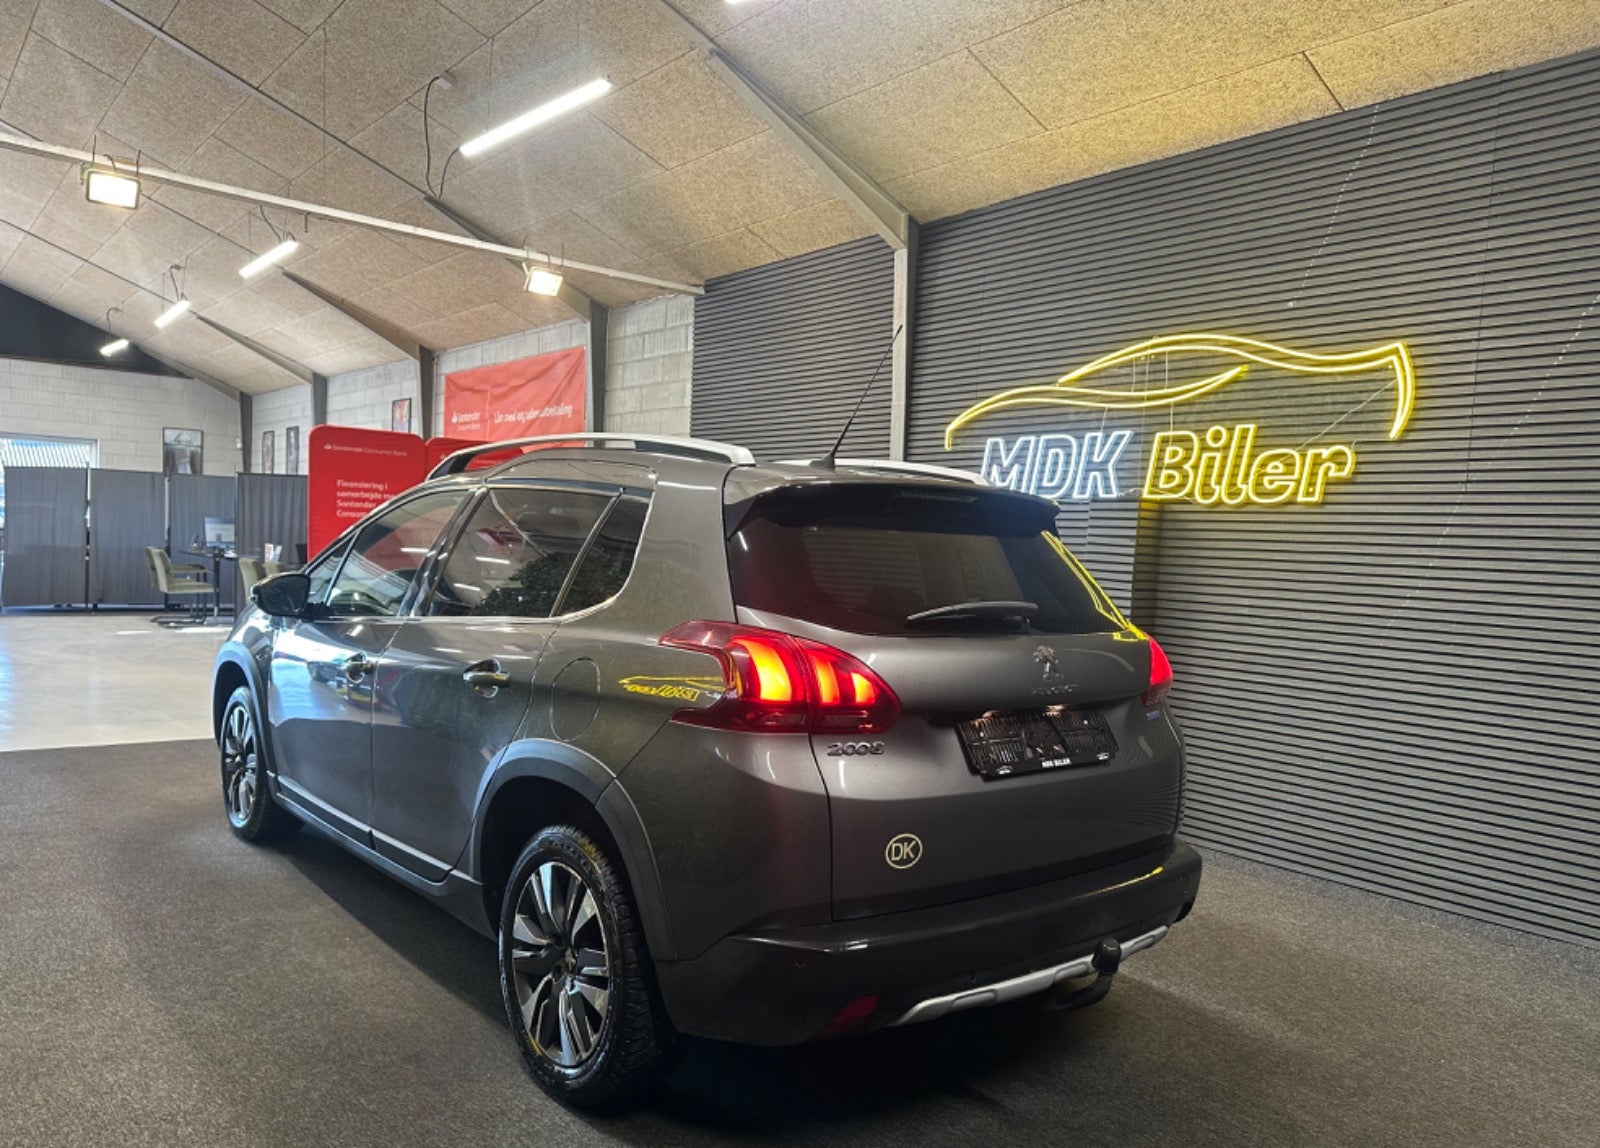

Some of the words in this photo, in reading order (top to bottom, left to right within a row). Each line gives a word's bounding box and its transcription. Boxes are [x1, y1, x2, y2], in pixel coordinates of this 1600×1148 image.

[981, 430, 1134, 500] MDK
[1143, 424, 1357, 504] Biler
[336, 480, 384, 491] Finansiering
[336, 491, 382, 501] samarbejde
[336, 500, 376, 509] Santander
[336, 510, 368, 518] Consum
[827, 741, 885, 757] 2008
[891, 840, 917, 861] DK
